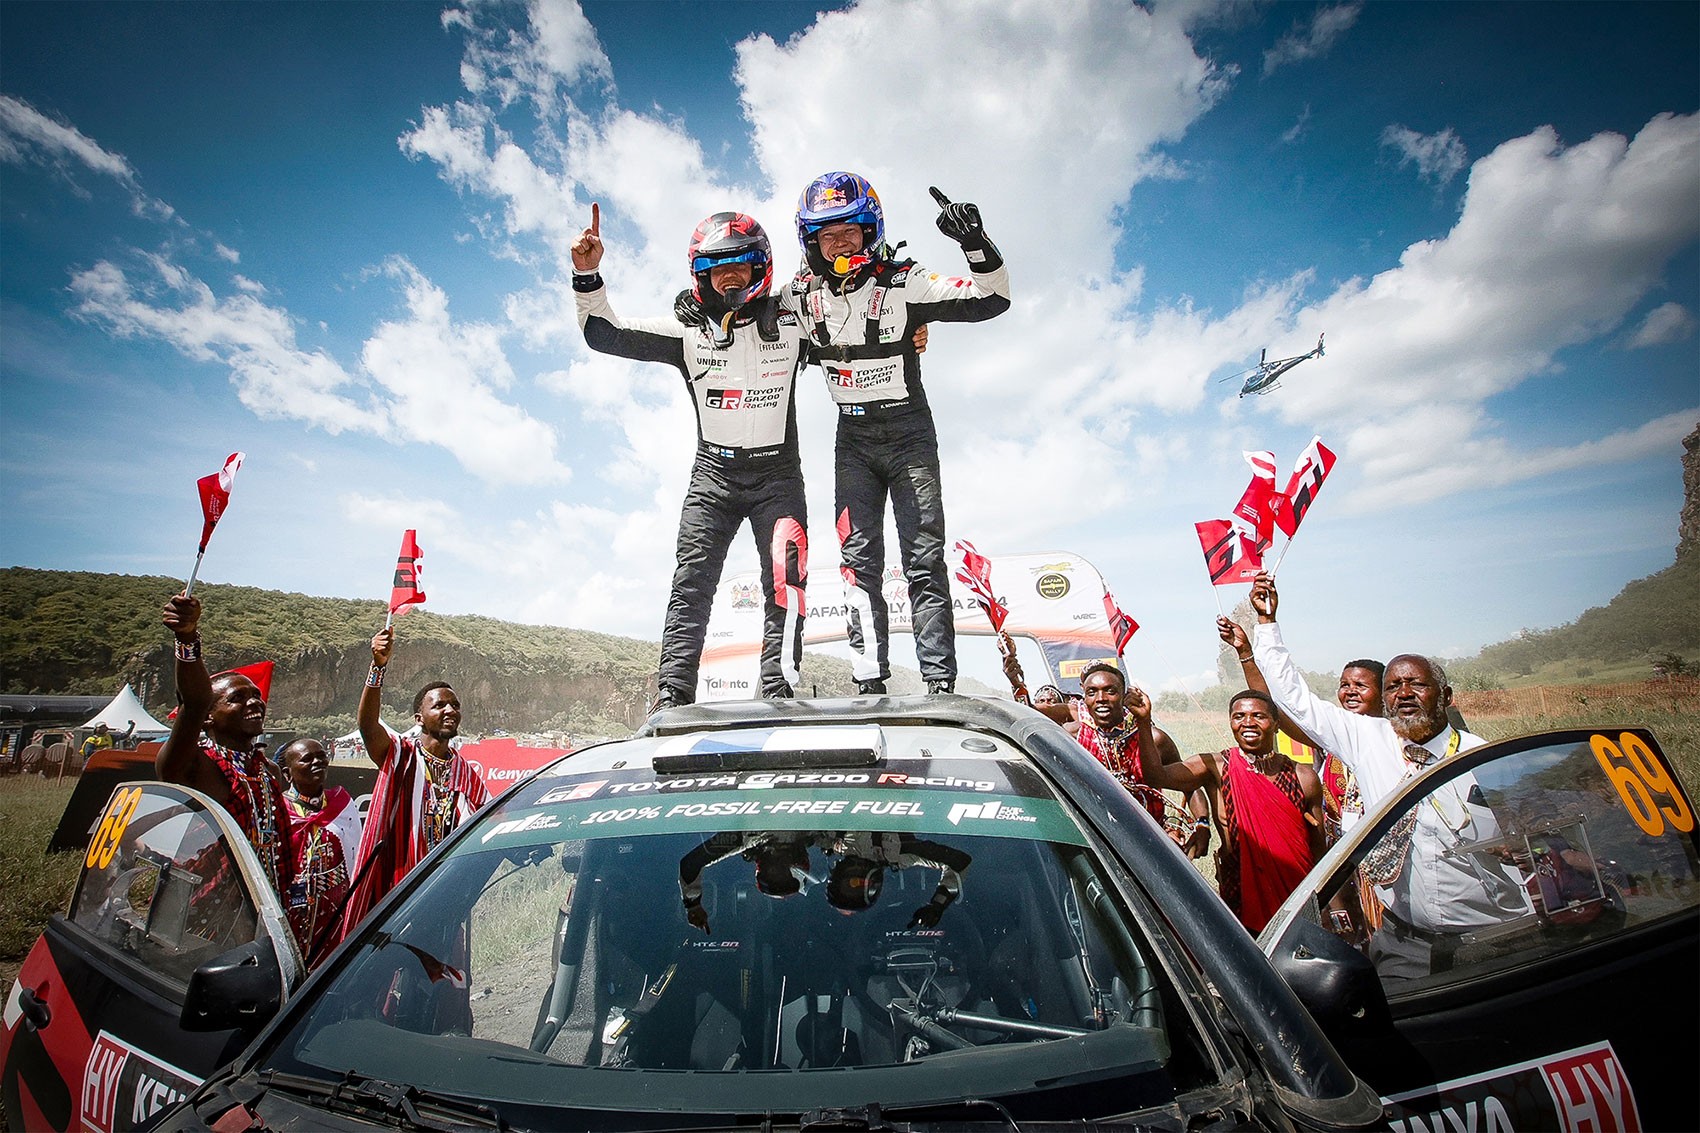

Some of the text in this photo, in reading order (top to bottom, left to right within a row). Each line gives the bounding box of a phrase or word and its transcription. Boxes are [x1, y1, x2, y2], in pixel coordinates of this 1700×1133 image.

[872, 289, 882, 316] SIMPSON
[696, 358, 728, 367] UNIBET
[855, 363, 897, 377] TOYOTA
[855, 370, 893, 384] GAZOO
[855, 376, 891, 389] Racing
[744, 393, 780, 403] GAZOO
[746, 386, 784, 396] TOYOTA
[743, 401, 778, 410] Racing
[608, 774, 736, 793] TOYOTA
[738, 773, 870, 789] GAZOO
[877, 773, 996, 791] Racing
[1589, 732, 1694, 837] 69
[580, 800, 925, 825] 100% FOSSIL-FREE FUEL
[996, 814, 1038, 823] CHANGE
[86, 787, 143, 869] 69
[84, 1043, 125, 1125] HY
[1551, 1057, 1626, 1133] HY
